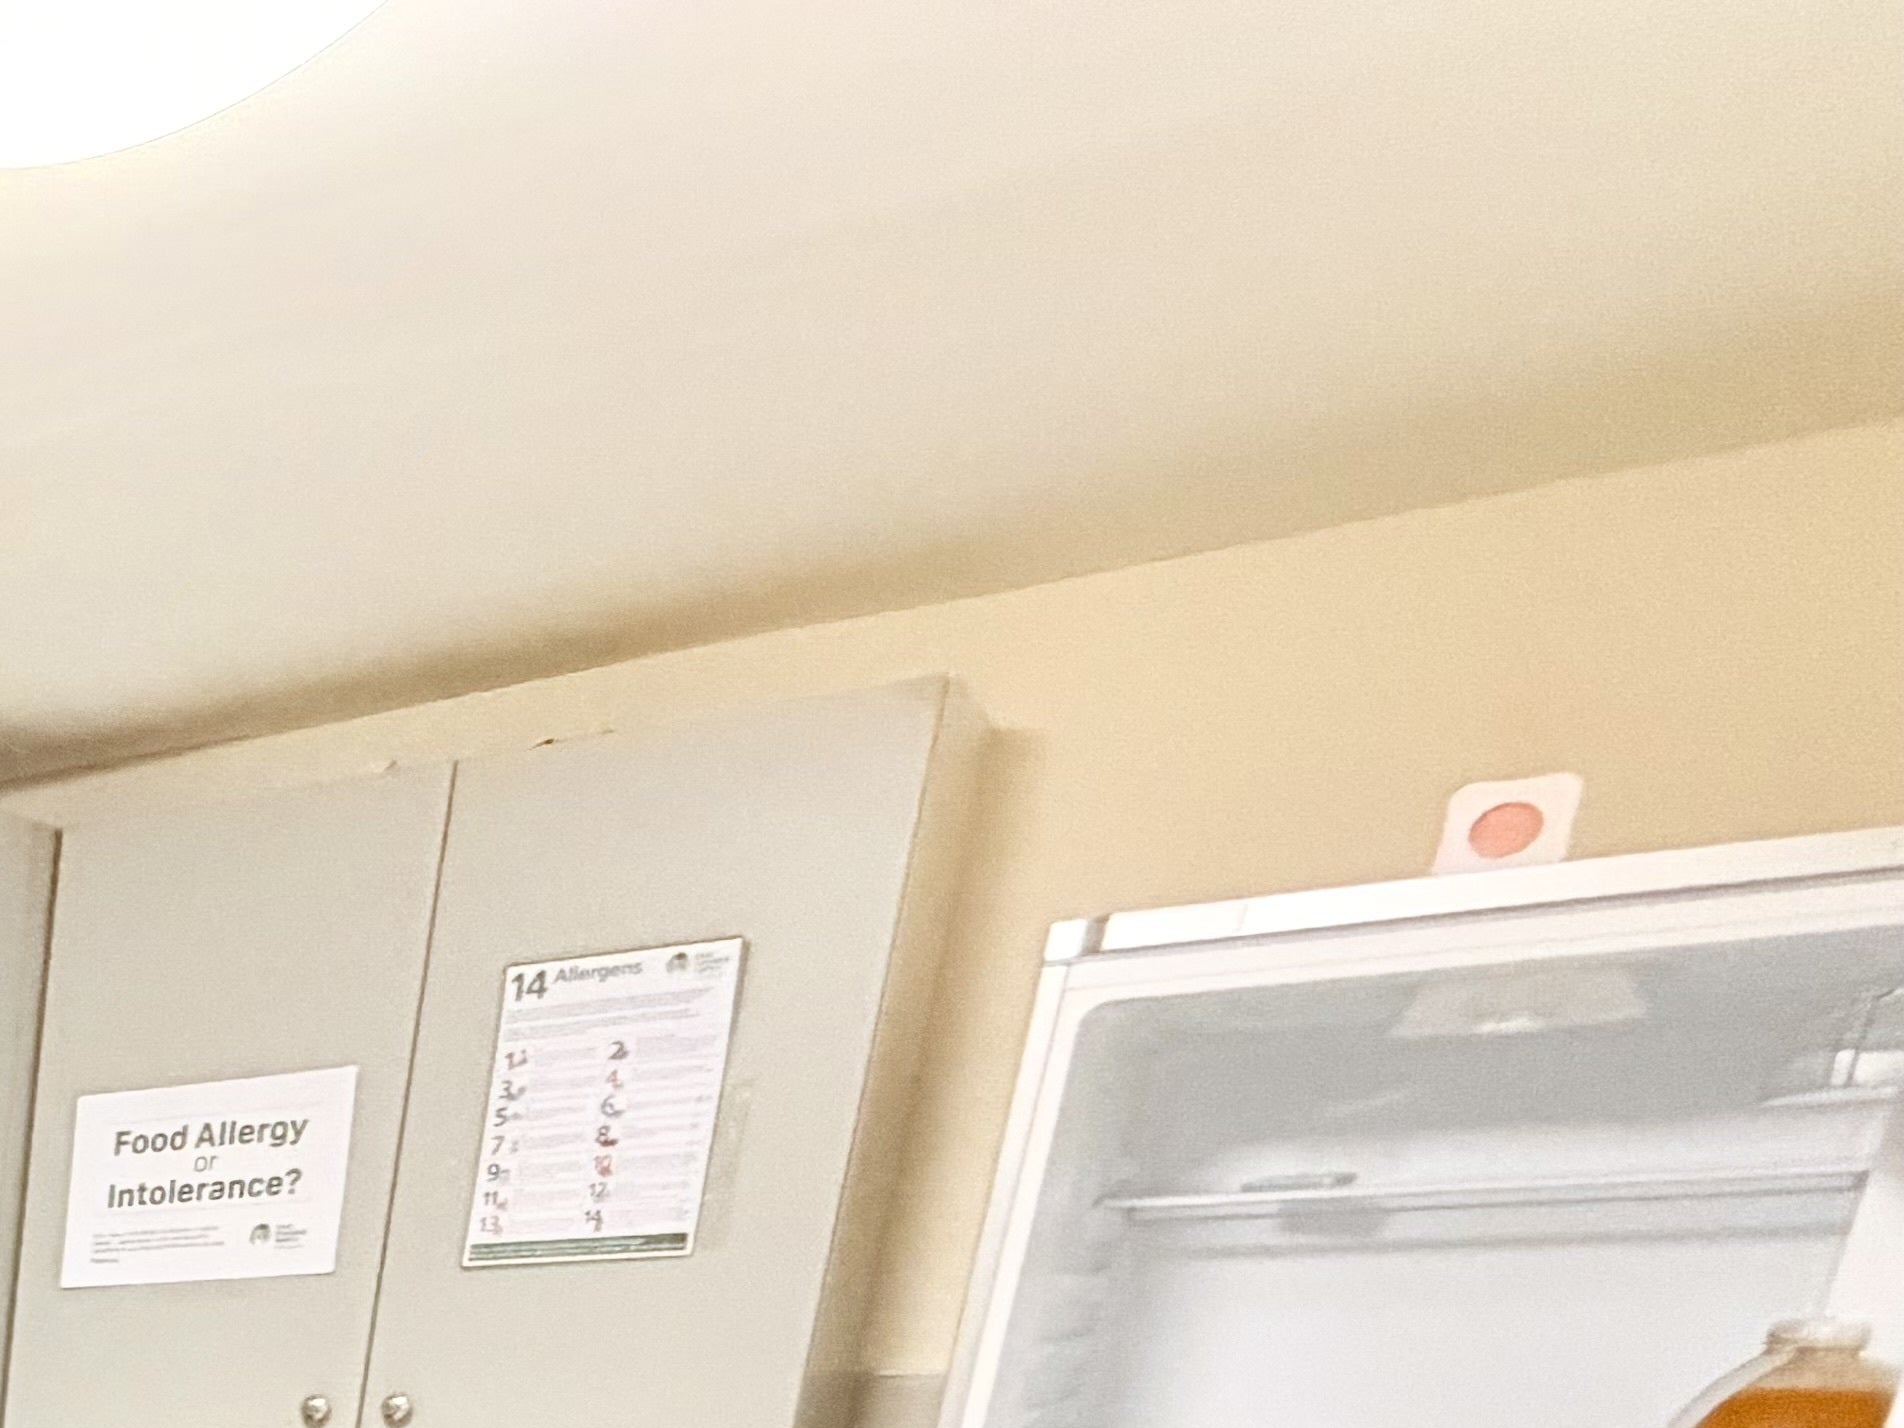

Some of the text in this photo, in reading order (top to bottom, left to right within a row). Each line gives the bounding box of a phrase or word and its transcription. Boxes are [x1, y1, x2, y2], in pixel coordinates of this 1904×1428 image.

[510, 962, 644, 1003] 14 Allergens
[608, 1040, 626, 1060] 2
[499, 1080, 513, 1099] 3
[493, 1106, 508, 1127] 5
[601, 1095, 615, 1117] 6
[113, 1117, 310, 1157] Food Allergy
[491, 1135, 506, 1156] 7
[596, 1125, 611, 1145] 8
[192, 1153, 219, 1173] or
[487, 1163, 501, 1182] 9
[107, 1167, 304, 1209] Intolerance?
